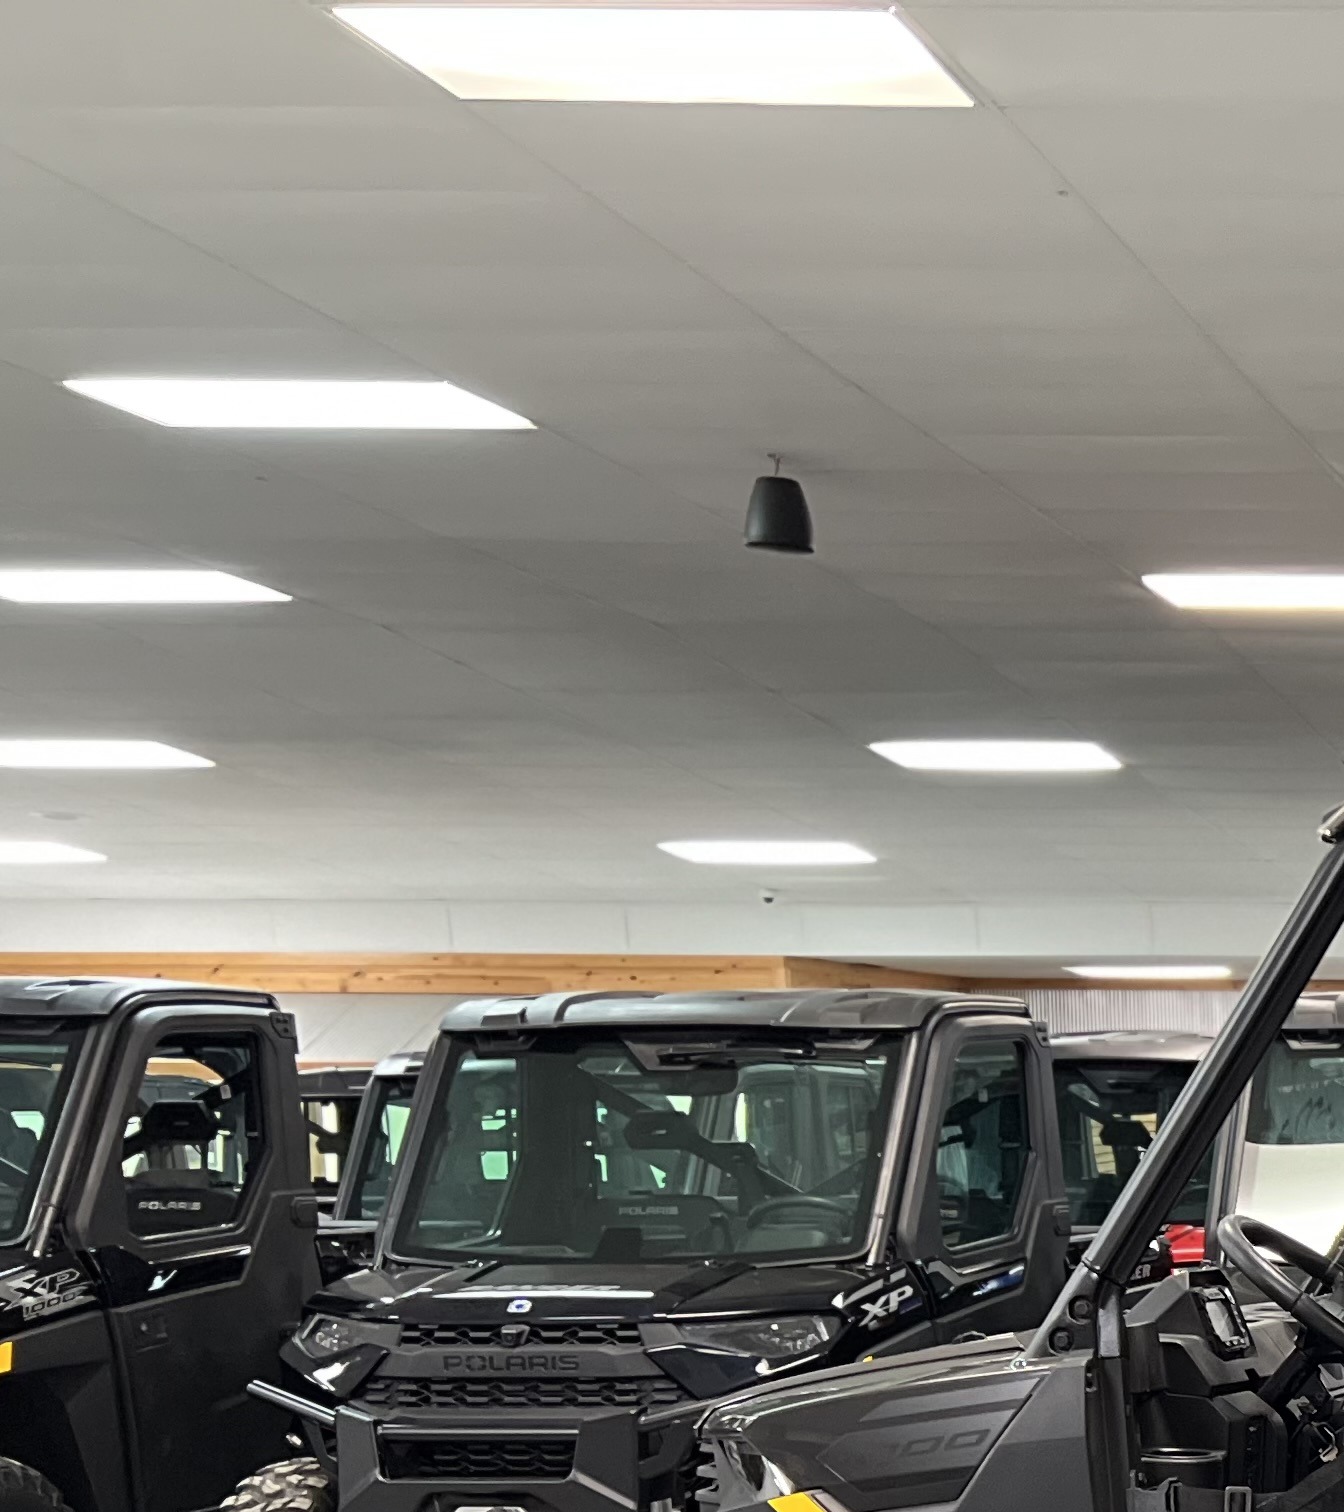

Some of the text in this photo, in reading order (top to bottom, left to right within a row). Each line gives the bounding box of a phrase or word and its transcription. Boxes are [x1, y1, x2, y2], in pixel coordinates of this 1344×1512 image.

[3, 1267, 81, 1312] XP
[858, 1285, 914, 1328] XP
[442, 1354, 580, 1373] POLARIS
